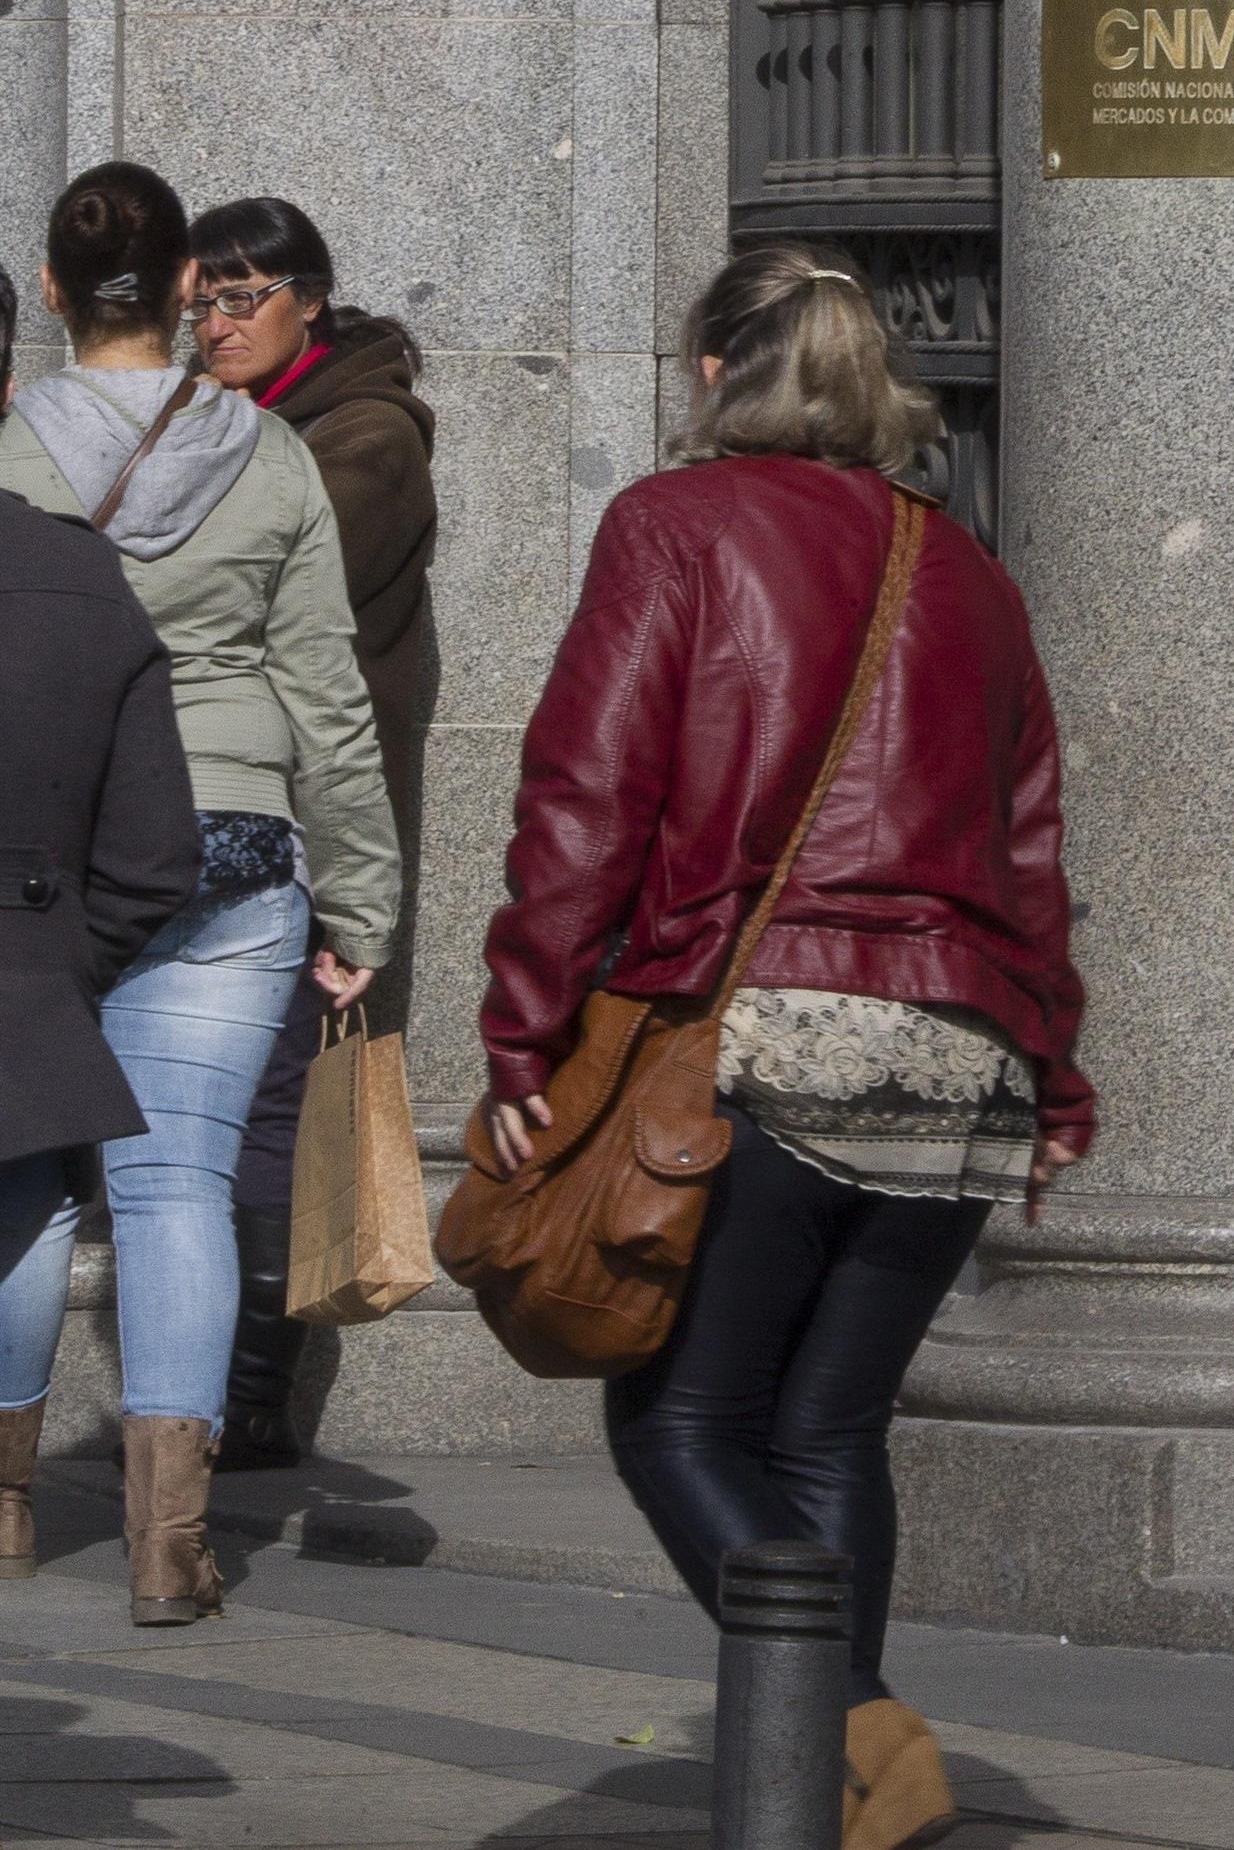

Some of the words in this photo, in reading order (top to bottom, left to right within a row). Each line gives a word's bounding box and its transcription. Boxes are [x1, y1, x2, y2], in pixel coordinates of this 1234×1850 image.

[1092, 78, 1160, 99] COMISIÓN
[1092, 107, 1165, 125] MERCADOS
[1168, 108, 1179, 125] Y
[1181, 108, 1200, 125] LA
